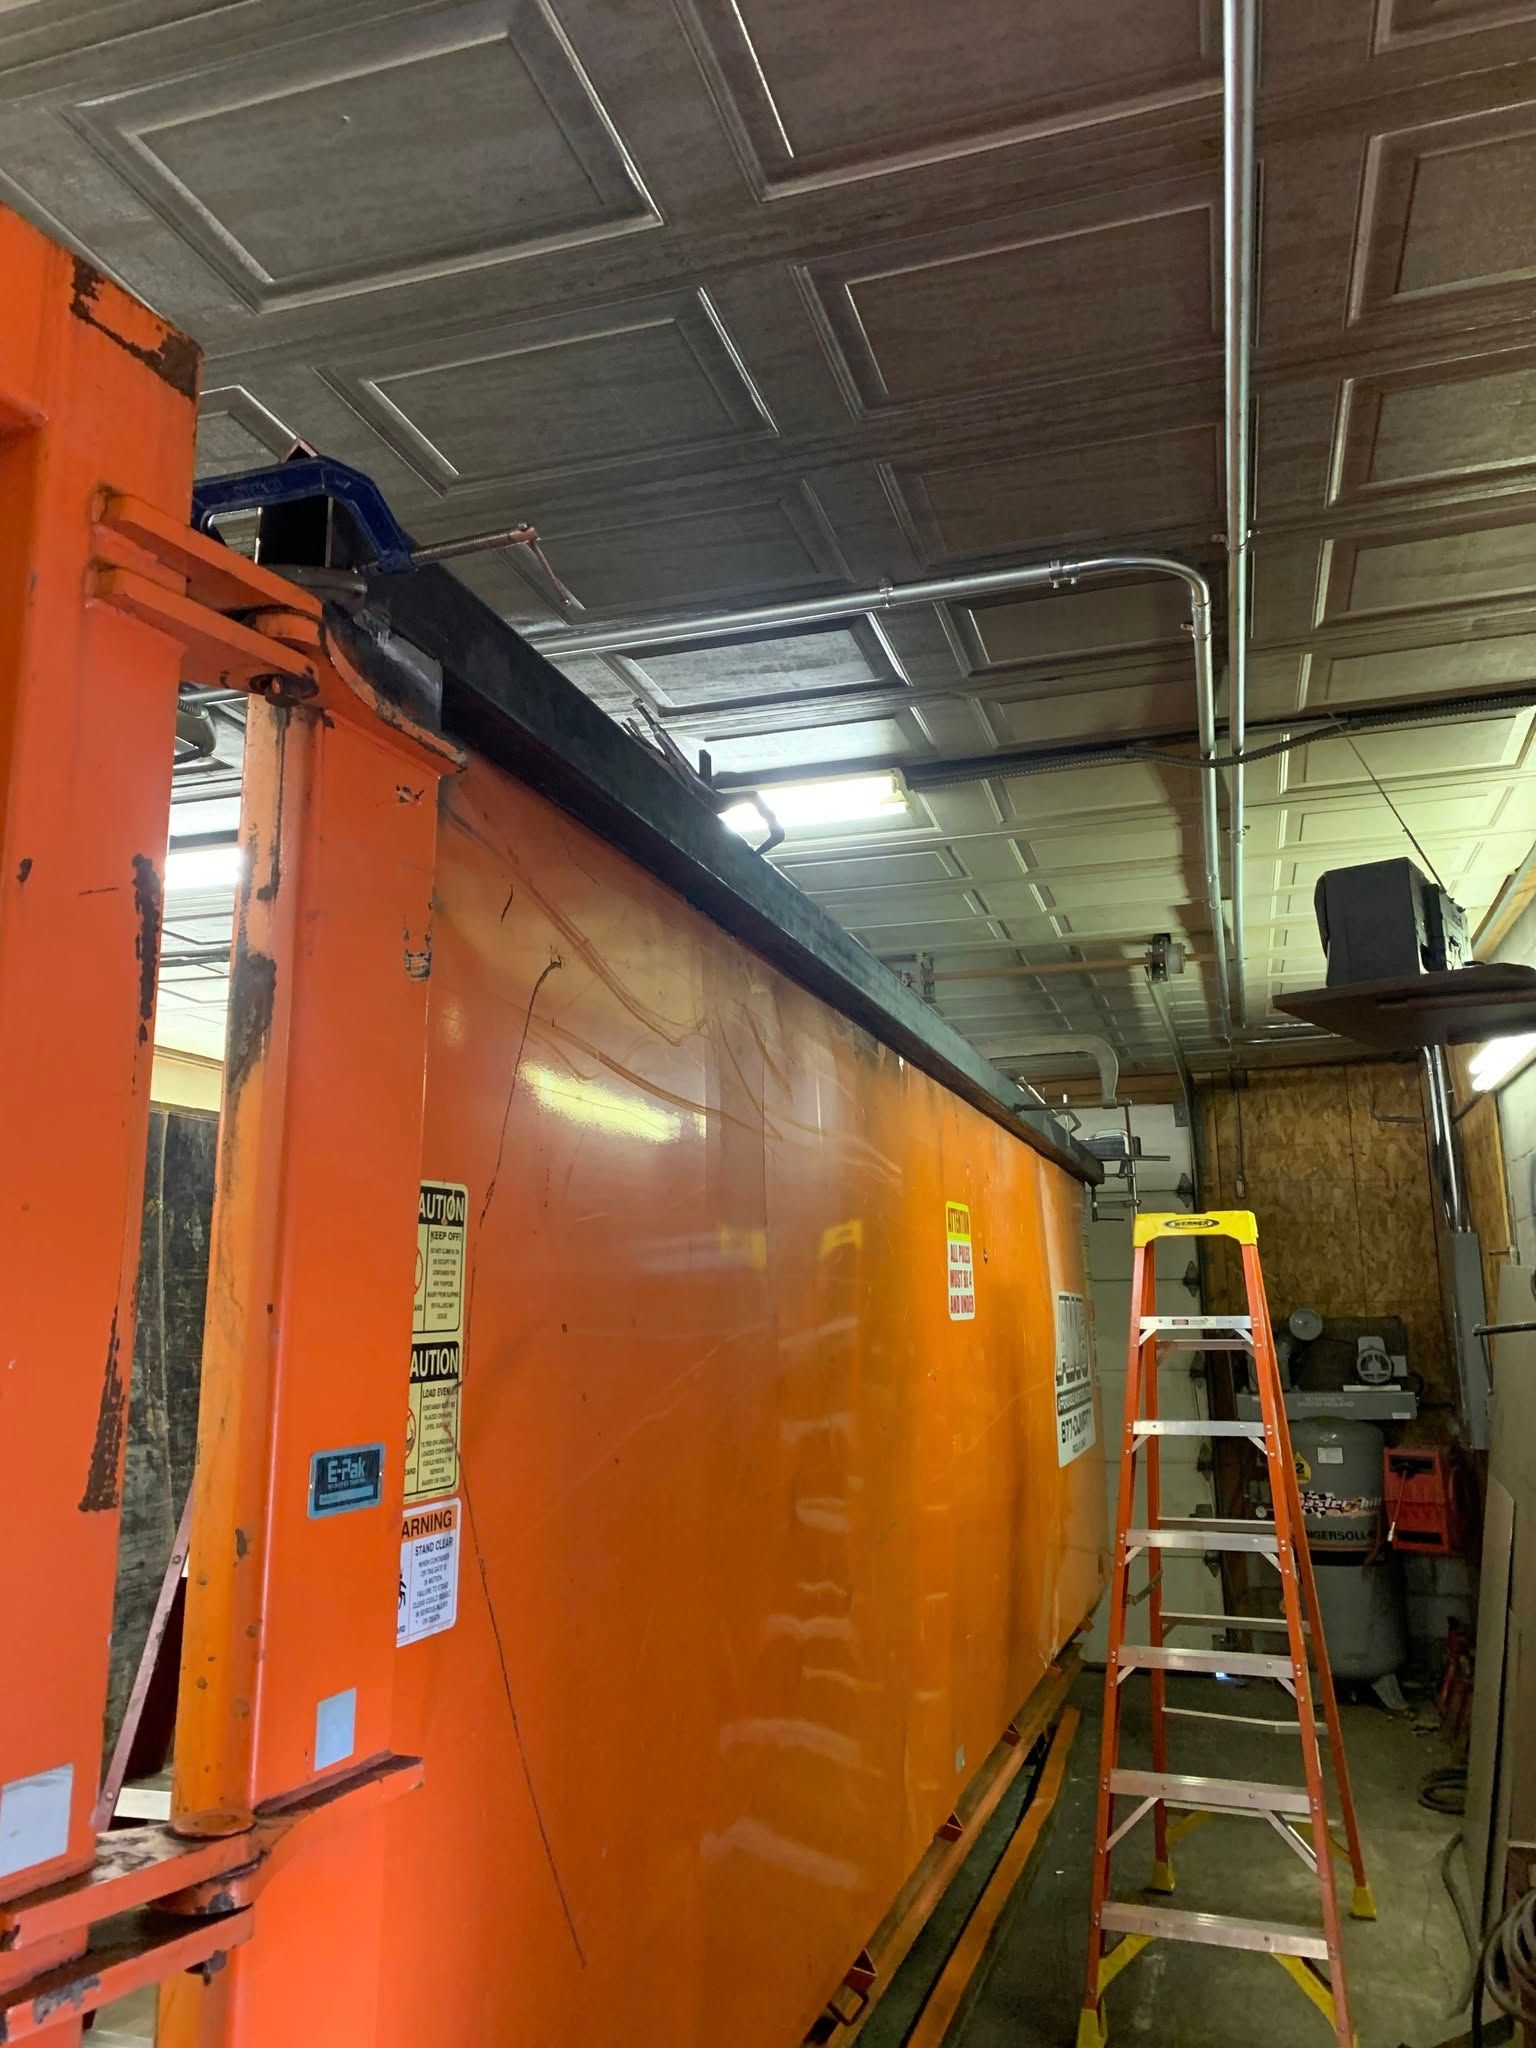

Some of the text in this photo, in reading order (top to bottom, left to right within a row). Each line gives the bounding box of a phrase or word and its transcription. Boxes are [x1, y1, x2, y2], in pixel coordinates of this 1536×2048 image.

[418, 1192, 464, 1222] AUTION
[430, 1230, 447, 1242] KEEP
[409, 1348, 458, 1377] AUTION
[422, 1389, 437, 1399] LOAD
[327, 1456, 366, 1483] E-Pak
[402, 1510, 452, 1538] ARNING
[1306, 1529, 1367, 1541] NGERSOLL
[415, 1542, 434, 1556] STAND
